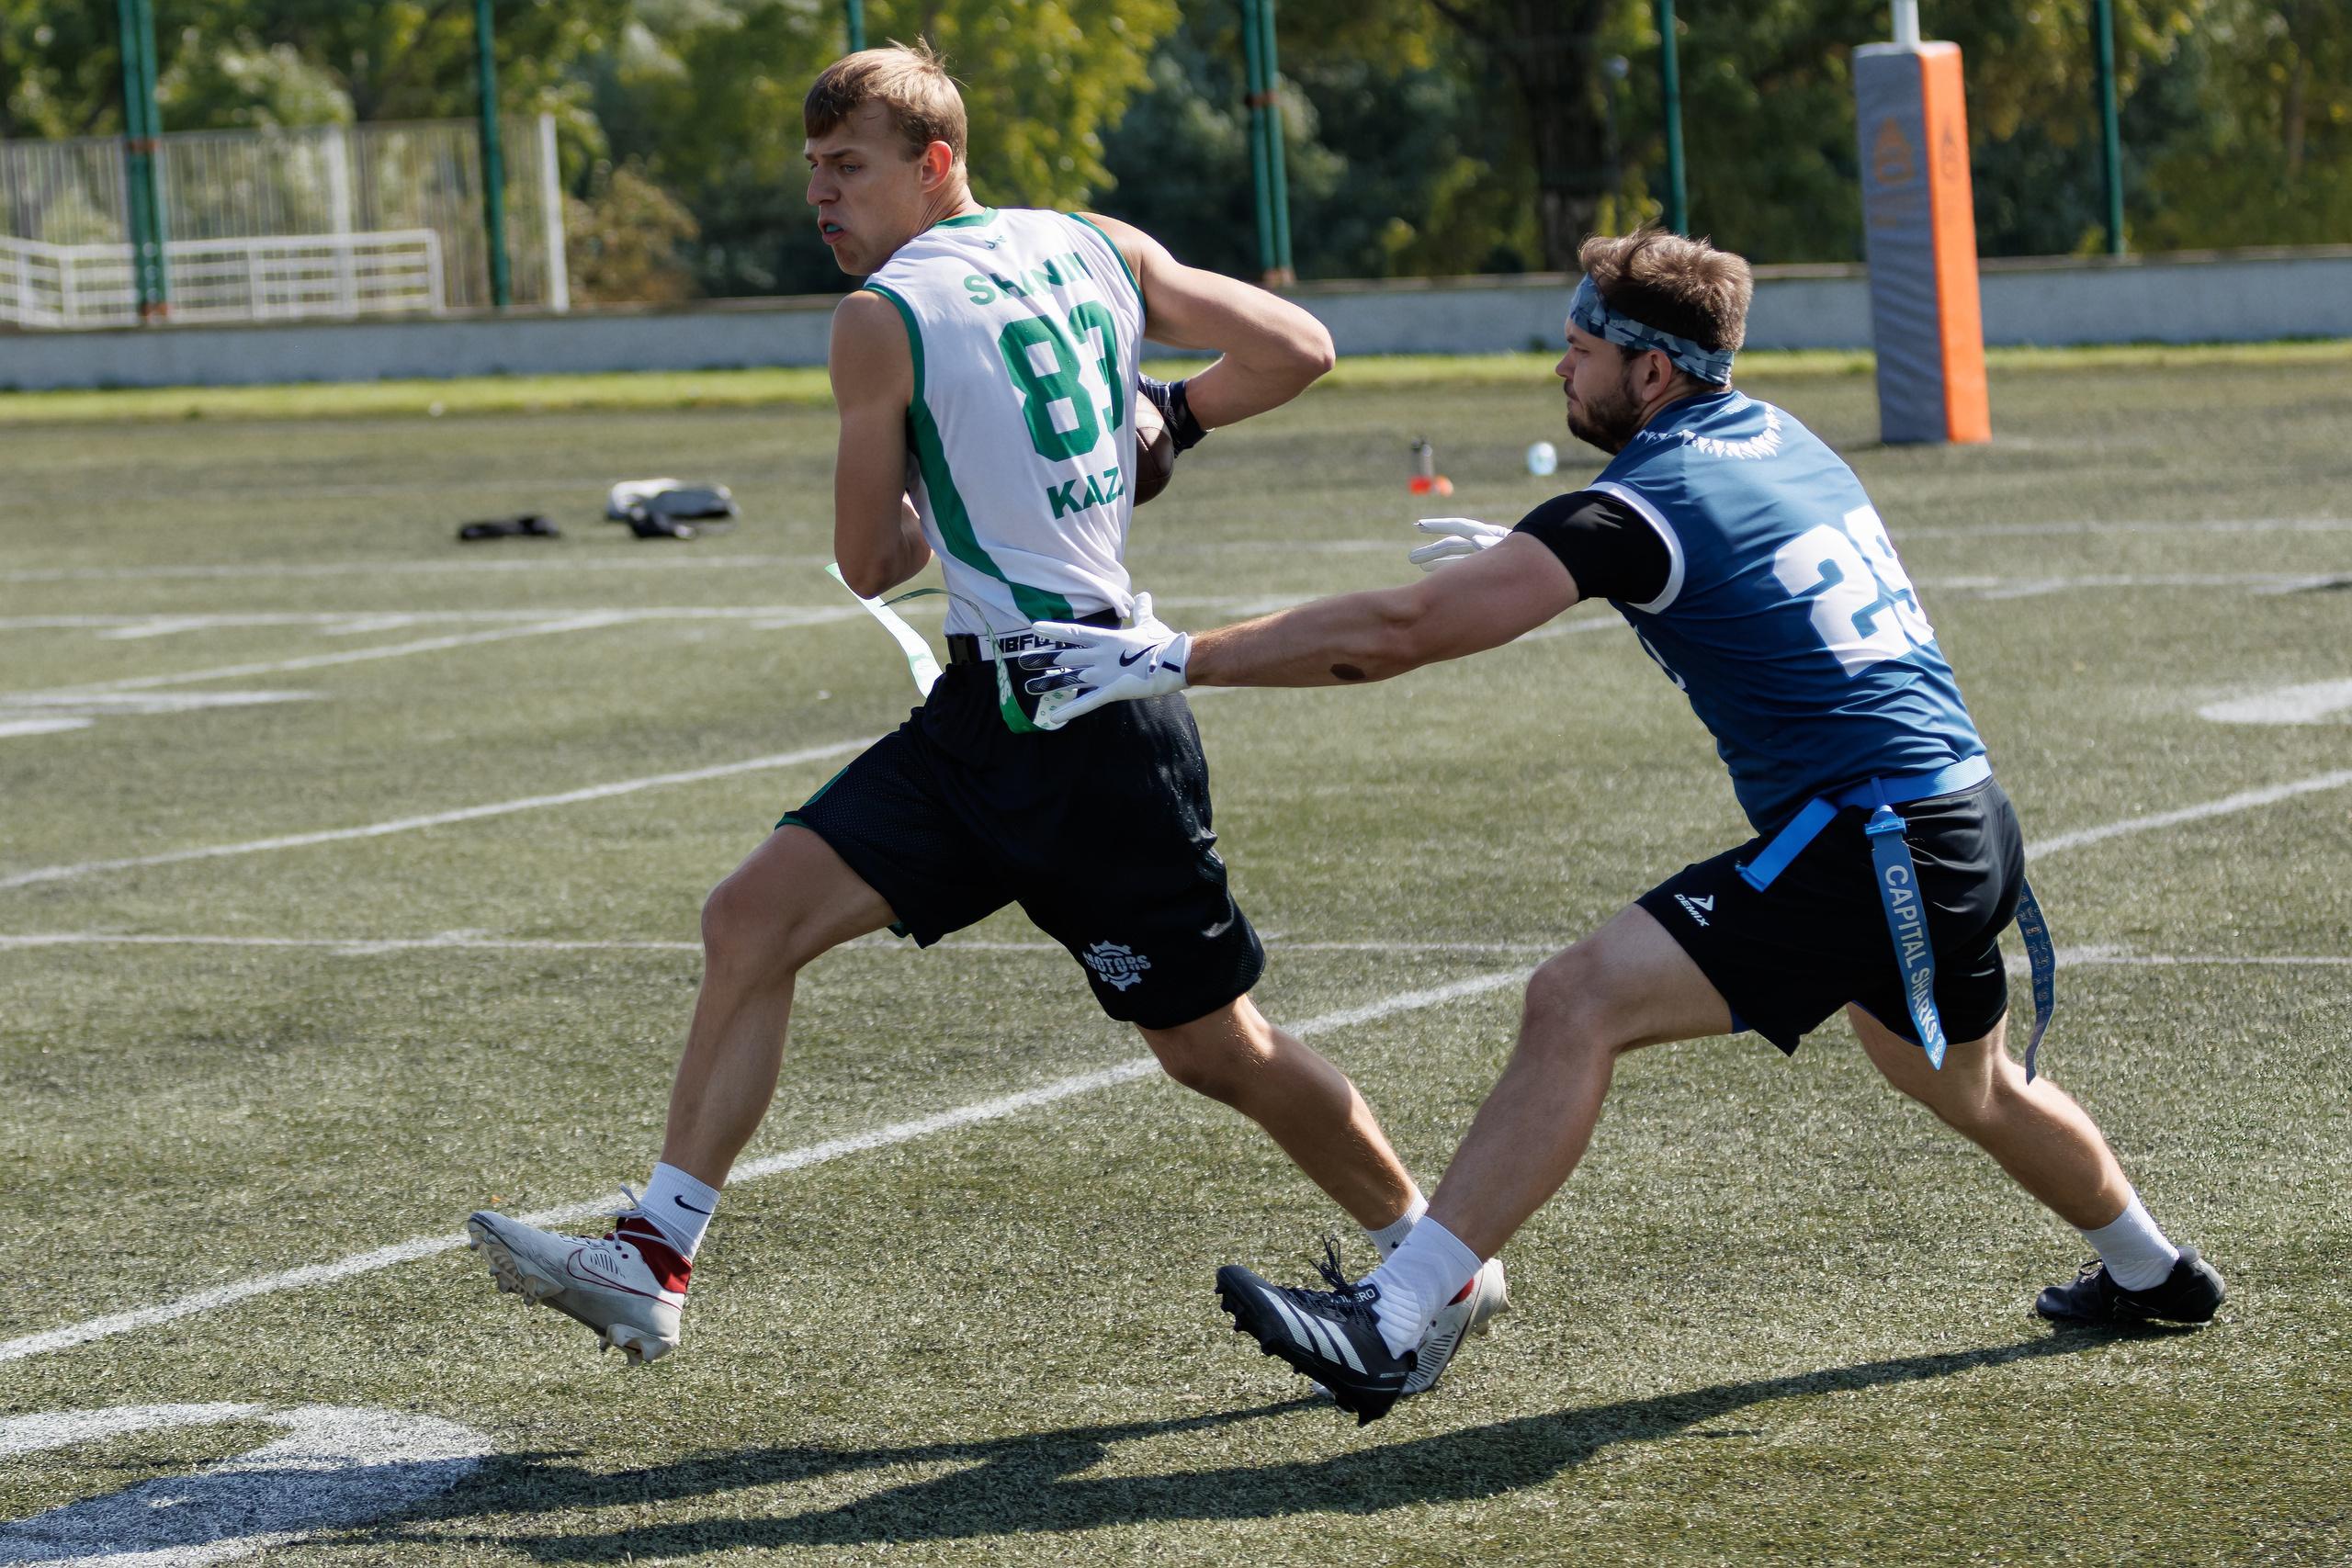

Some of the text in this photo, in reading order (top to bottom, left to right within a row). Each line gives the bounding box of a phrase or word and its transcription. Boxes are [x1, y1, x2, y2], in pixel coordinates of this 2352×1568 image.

[998, 299, 1125, 462] 83
[1674, 894, 1711, 927] DEMIX
[1884, 864, 1938, 1043] CAPITAL SHARKS
[1082, 950, 1152, 974] MOTORS
